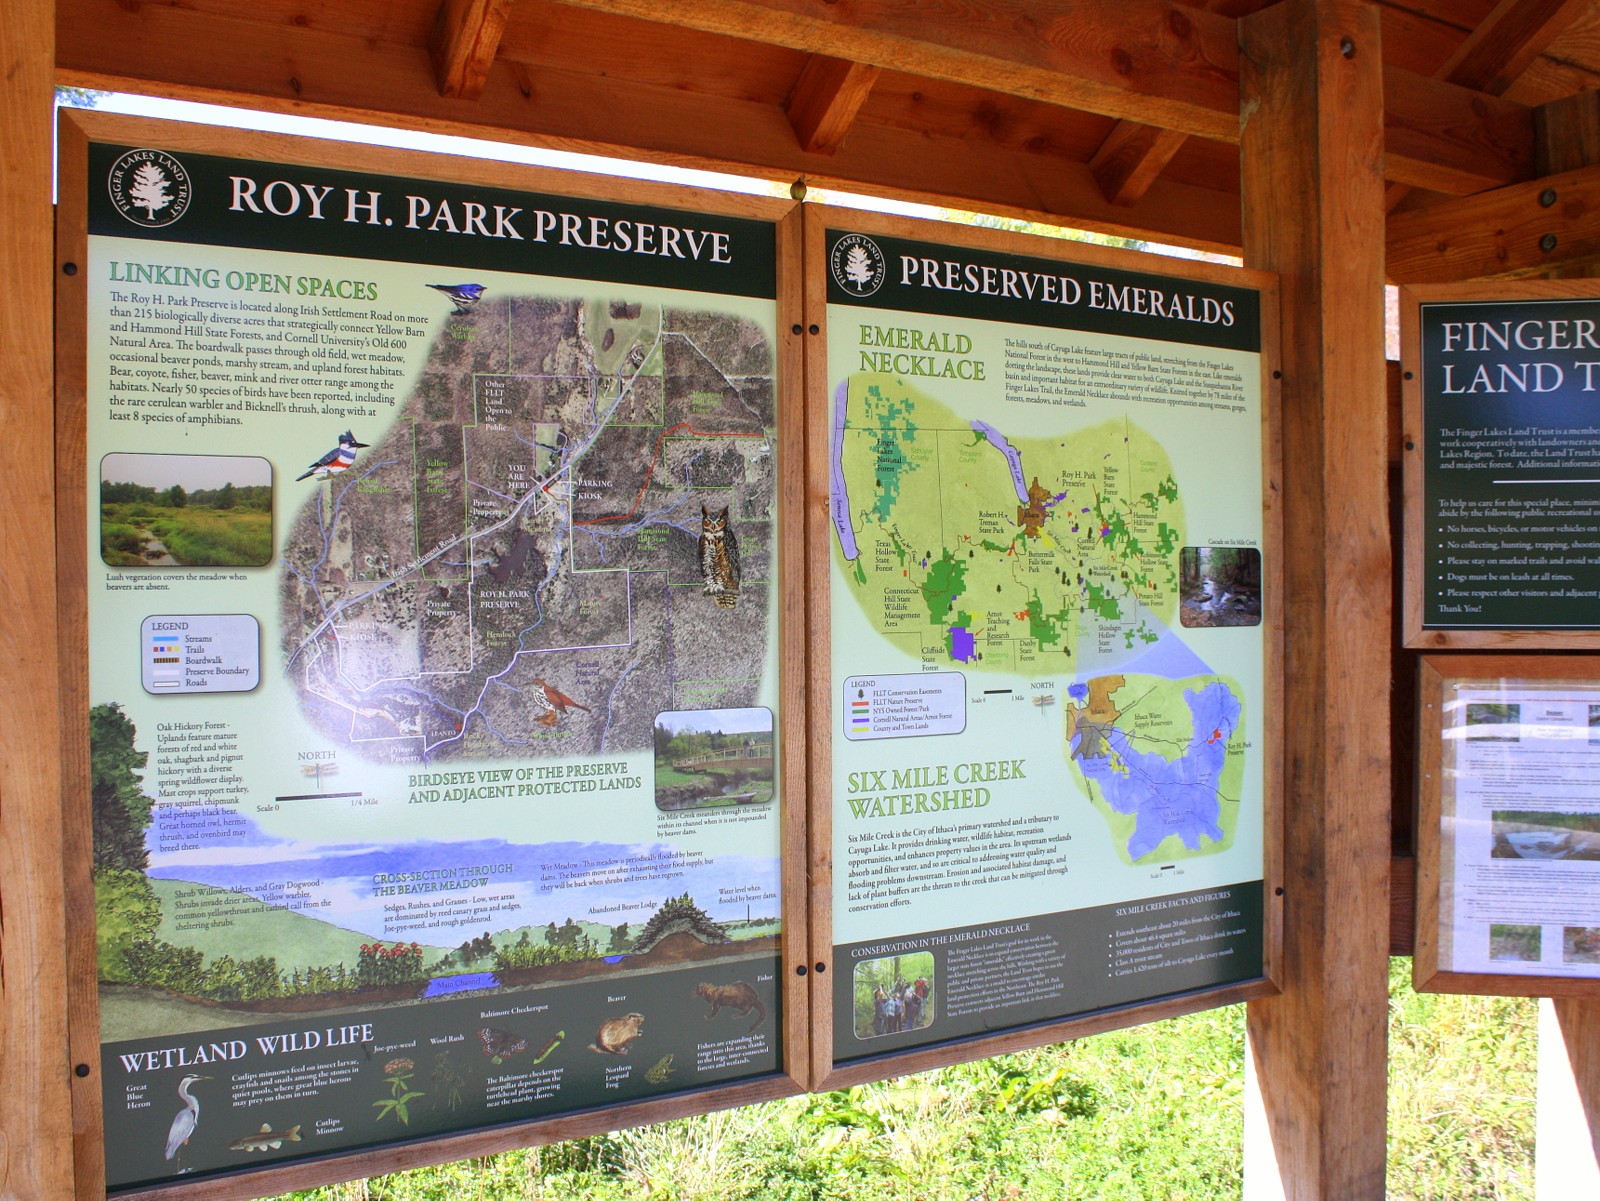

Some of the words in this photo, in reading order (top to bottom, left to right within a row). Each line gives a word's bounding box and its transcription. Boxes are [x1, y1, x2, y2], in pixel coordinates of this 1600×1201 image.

[120, 151, 155, 170] LAKES
[158, 154, 184, 181] LAND
[112, 170, 131, 212] FINGER
[170, 184, 188, 218] TRUST
[228, 176, 334, 220] ROY
[344, 188, 394, 227] H.
[404, 195, 524, 241] PARK
[533, 210, 732, 264] PRESERVE
[838, 236, 861, 250] LAKES
[862, 239, 880, 260] LAND
[834, 251, 846, 285] FINGER
[109, 261, 220, 289] LINKING
[225, 270, 292, 294] OPEN
[296, 276, 378, 301] SPACES
[871, 262, 883, 289] TRUST
[900, 255, 1082, 306] PRESERVED
[1088, 280, 1235, 327] EMERALDS
[110, 290, 128, 302] The
[130, 292, 150, 307] Roy
[152, 294, 165, 305] H.
[167, 295, 188, 306] Park
[190, 296, 228, 309] Preserve
[230, 300, 238, 310] is
[239, 299, 272, 312] located
[274, 302, 299, 318] along
[300, 304, 320, 316] Irish
[321, 306, 368, 319] Settlement
[370, 310, 392, 321] Road
[393, 314, 405, 322] on
[407, 315, 429, 324] more
[109, 305, 132, 317] than
[134, 307, 152, 319] 215
[154, 308, 208, 325] biologically
[209, 312, 241, 324] diverse
[243, 318, 265, 326] acres
[267, 316, 285, 327] that
[287, 320, 338, 334] strategically
[339, 324, 374, 334] connect
[375, 324, 404, 335] Yellow
[405, 326, 425, 337] Barn
[859, 324, 972, 354] EMERALD
[1441, 319, 1600, 352] FINGER
[859, 350, 986, 381] NECKLACE
[1441, 362, 1564, 394] LAND
[109, 409, 131, 421] least
[132, 410, 139, 421] 8
[141, 412, 174, 425] species
[175, 411, 187, 423] of
[187, 413, 243, 427] amphibians.
[508, 464, 526, 472] YOU
[106, 572, 124, 581] Lush
[125, 573, 162, 583] vegetation
[186, 572, 198, 580] the
[198, 572, 228, 580] meadow
[228, 572, 247, 580] when
[1446, 572, 1468, 583] Dogs
[1488, 572, 1498, 581] be
[1510, 572, 1530, 580] leash
[1540, 572, 1550, 580] all
[106, 582, 132, 590] beavers
[145, 582, 170, 590] absent.
[480, 590, 496, 598] ROY
[498, 590, 508, 598] H.
[508, 590, 530, 598] PARK
[1438, 604, 1462, 612] Thank
[1463, 604, 1482, 612] You!
[151, 621, 189, 631] LEGEND
[184, 634, 212, 643] Streams
[184, 644, 205, 654] Trails
[185, 655, 223, 665] Boardwalk
[185, 667, 214, 676] Preserve
[215, 666, 249, 676] Boundary
[185, 677, 207, 687] Roads
[851, 680, 876, 688] LEGEND
[1030, 681, 1054, 689] NORTH
[156, 722, 172, 732] Oak
[173, 721, 203, 732] Hickory
[204, 721, 226, 729] Forest
[297, 750, 336, 760] NORTH
[408, 771, 476, 787] BIRDSEYE
[476, 768, 514, 782] VIEW
[515, 767, 534, 781] OF
[535, 766, 564, 779] THE
[566, 761, 628, 778] PRESERVE
[847, 770, 887, 794] SIX
[891, 765, 949, 790] MILE
[953, 759, 1026, 784] CREEK
[408, 789, 440, 804] AND
[442, 784, 515, 803] ADJACENT
[517, 779, 597, 796] PROTECTED
[599, 776, 641, 791] LANDS
[256, 804, 274, 812] Scale
[274, 803, 280, 811] 0
[363, 797, 378, 805] Mile
[846, 787, 990, 819] WATERSHED
[848, 834, 858, 843] Six
[859, 832, 874, 842] Mile
[875, 830, 894, 840] Creek
[901, 828, 912, 838] the
[912, 828, 926, 837] City
[927, 825, 935, 835] of
[935, 824, 957, 834] Ithaca's
[957, 823, 981, 834] primary
[982, 817, 1011, 828] watershed
[1012, 816, 1022, 826] and
[1027, 815, 1052, 824] tributary
[372, 868, 457, 885] CROSS-SECTION
[458, 863, 513, 877] THROUGH
[372, 885, 396, 897] THE
[397, 882, 438, 895] BEAVER
[439, 877, 489, 891] MEADOW
[851, 939, 918, 958] CONSERVATION
[919, 938, 929, 947] IN
[930, 935, 947, 946] THE
[949, 929, 988, 943] EMERALD
[988, 922, 1030, 937] NECKLACE
[757, 974, 773, 982] Fisher
[607, 995, 626, 1003] Beaver
[480, 1010, 510, 1018] Baltimore
[510, 1004, 548, 1014] Checkerspot
[430, 1035, 447, 1044] Wool
[448, 1033, 464, 1042] Rush
[119, 1040, 247, 1073] WETLAND
[256, 1030, 320, 1055] WILD
[326, 1023, 374, 1047] LIFE
[373, 1039, 416, 1054] Joe-pye-weed
[605, 1065, 632, 1074] Northern
[605, 1070, 629, 1081] Leopard
[125, 1084, 147, 1092] Great
[126, 1092, 143, 1101] Blue
[127, 1101, 151, 1109] Heron
[315, 1118, 340, 1127] Cutlips
[316, 1126, 344, 1135] Minnow
